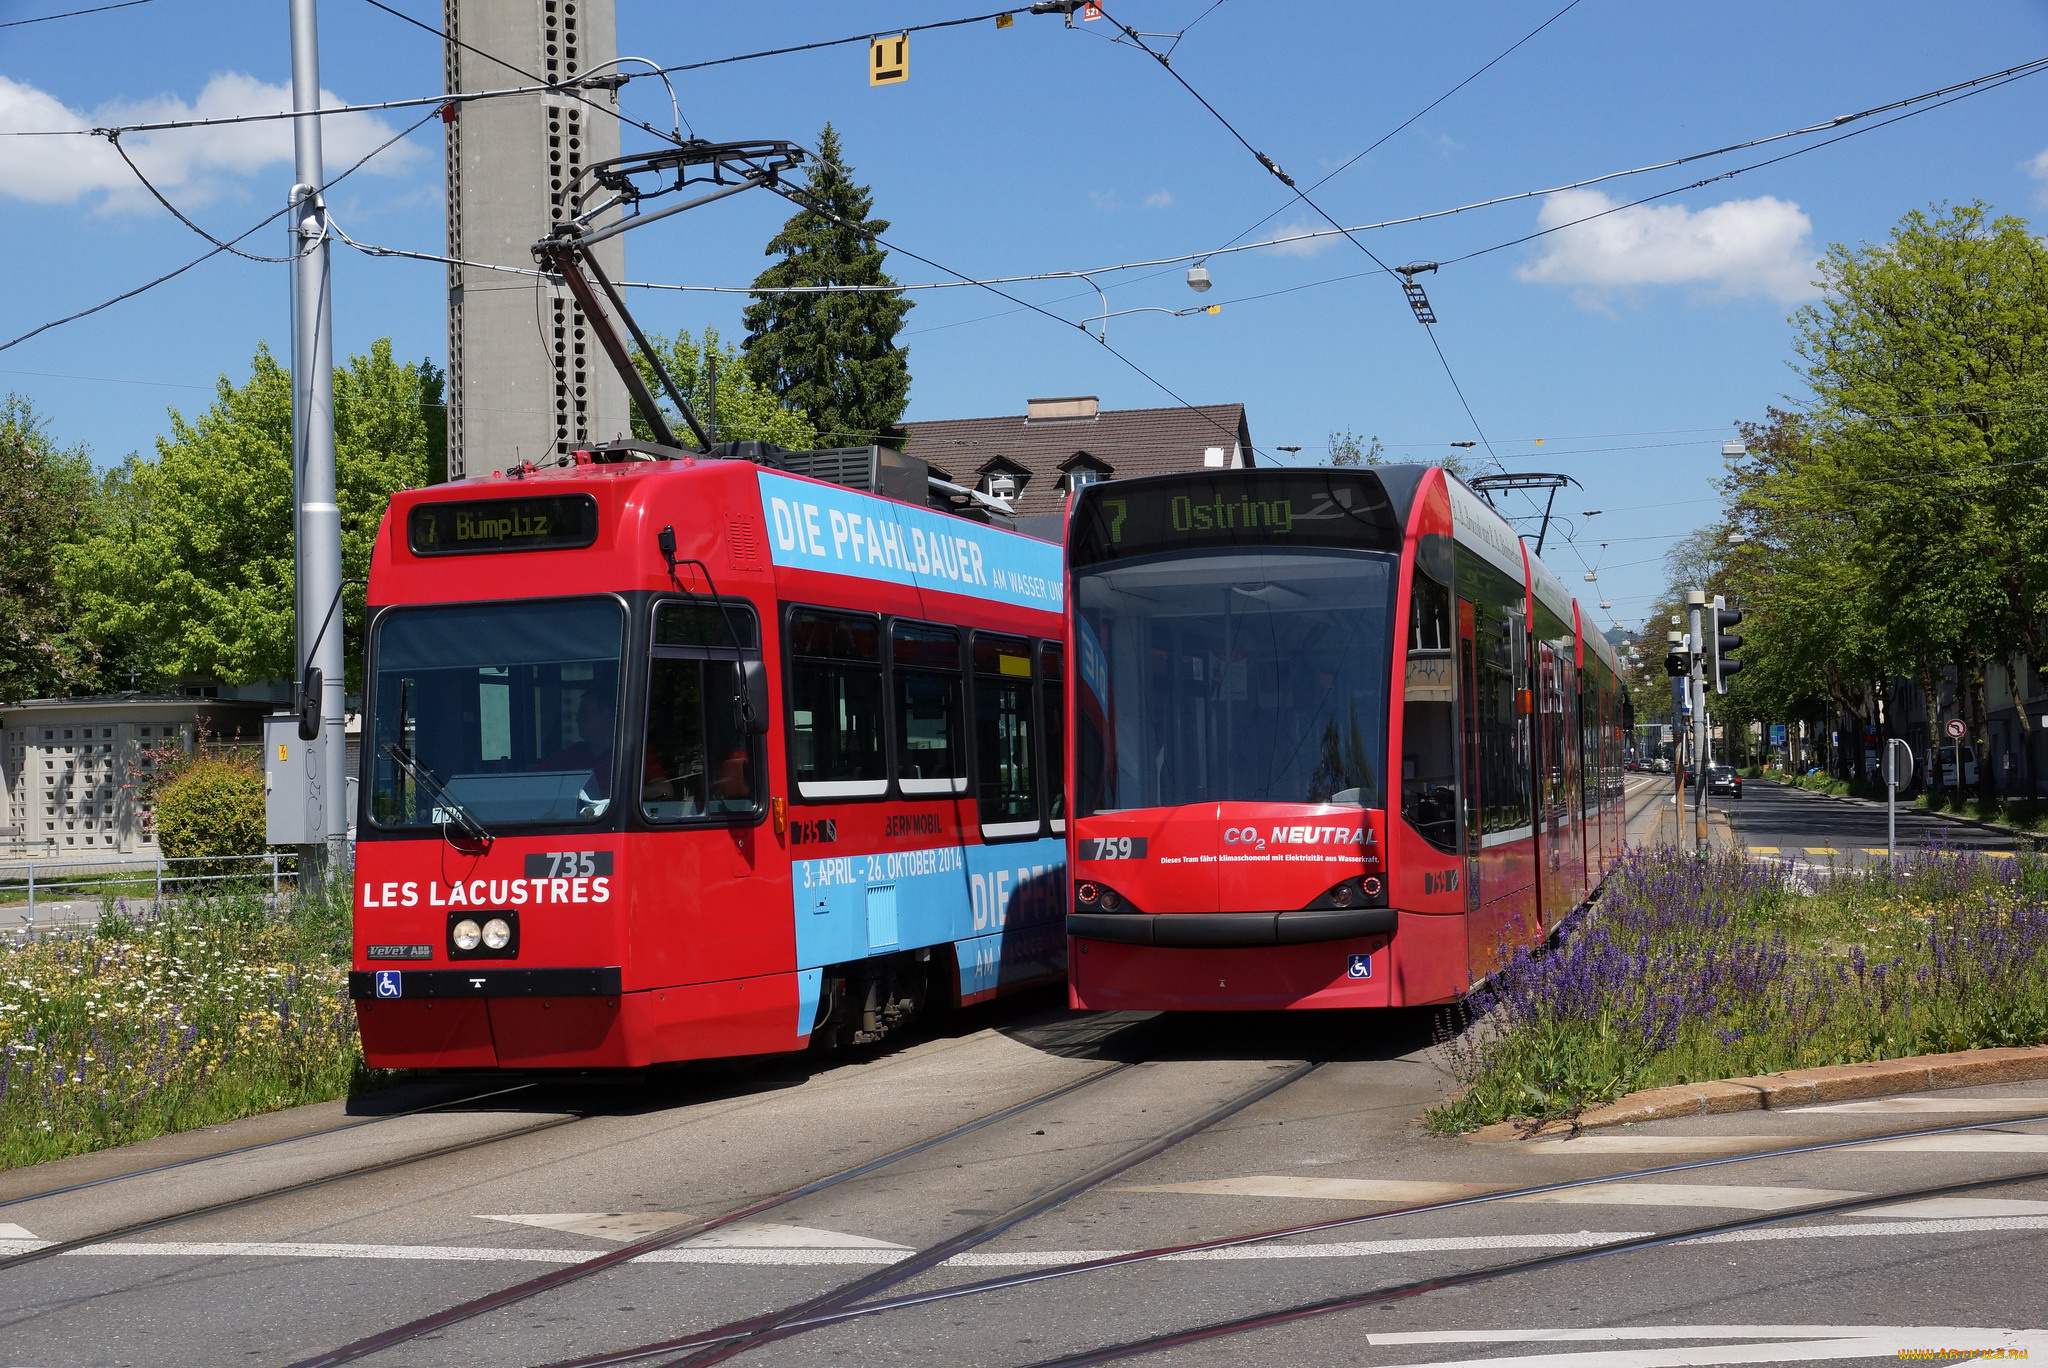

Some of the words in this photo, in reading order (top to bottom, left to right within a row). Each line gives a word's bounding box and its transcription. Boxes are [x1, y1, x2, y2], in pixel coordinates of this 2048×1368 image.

[423, 514, 437, 544] 7
[456, 507, 548, 541] Bümpliz
[1102, 499, 1127, 543] 7
[1172, 494, 1292, 534] Ostring
[771, 497, 826, 557] DIE
[829, 509, 987, 586] PFAHLBAUER
[992, 567, 1008, 591] AM
[1008, 571, 1047, 600] WASSER
[1093, 837, 1132, 860] 759
[1271, 826, 1379, 845] NEUTRAL
[546, 851, 595, 879] 735
[803, 861, 816, 889] 3.
[818, 857, 857, 887] APRIL
[867, 854, 885, 882] 26.
[887, 849, 936, 879] OKTOBER
[938, 846, 963, 873] 2014
[1219, 854, 1270, 862] klimaschonend
[1285, 854, 1323, 862] Elektrizität
[1338, 855, 1380, 863] Wasserkraft.
[364, 882, 419, 908] LES
[430, 877, 610, 906] LACUSTRES
[971, 870, 1010, 931] DIE
